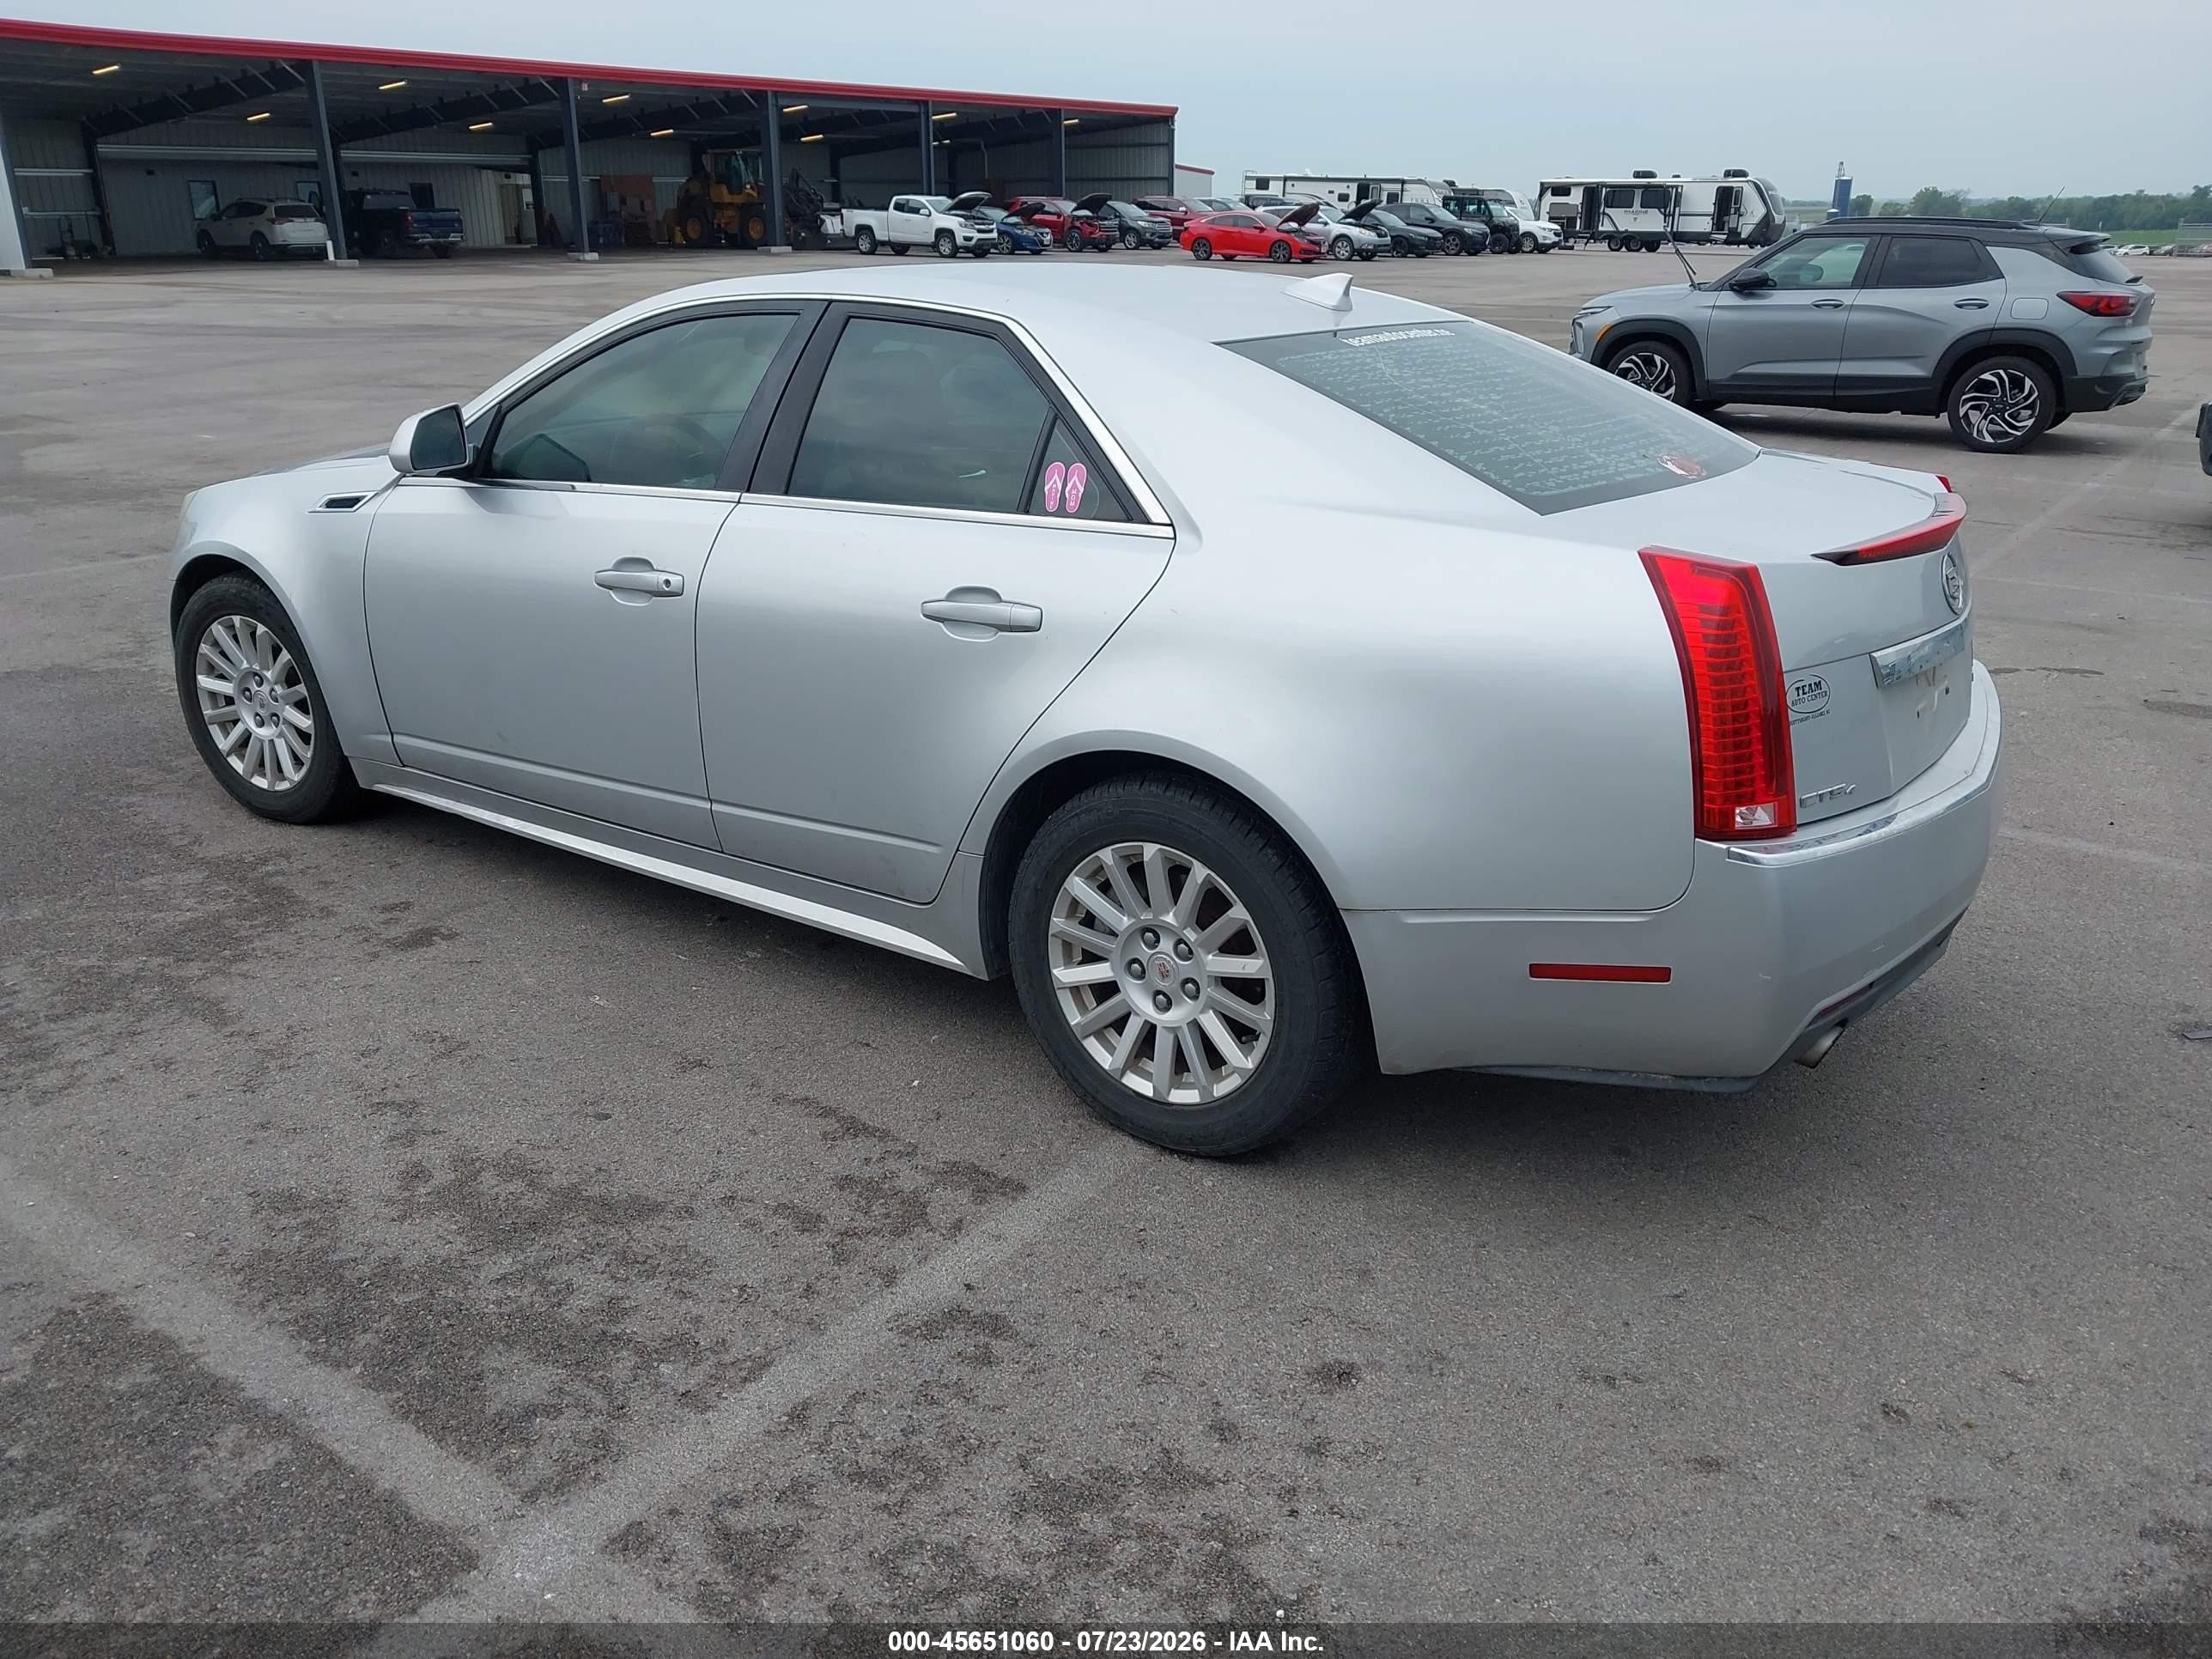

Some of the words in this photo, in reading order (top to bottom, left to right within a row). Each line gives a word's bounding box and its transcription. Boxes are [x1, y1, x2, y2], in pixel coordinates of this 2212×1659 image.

[1795, 680, 1822, 697] TEAM
[1791, 697, 1806, 707] AUTO
[1807, 690, 1828, 702] CENTER
